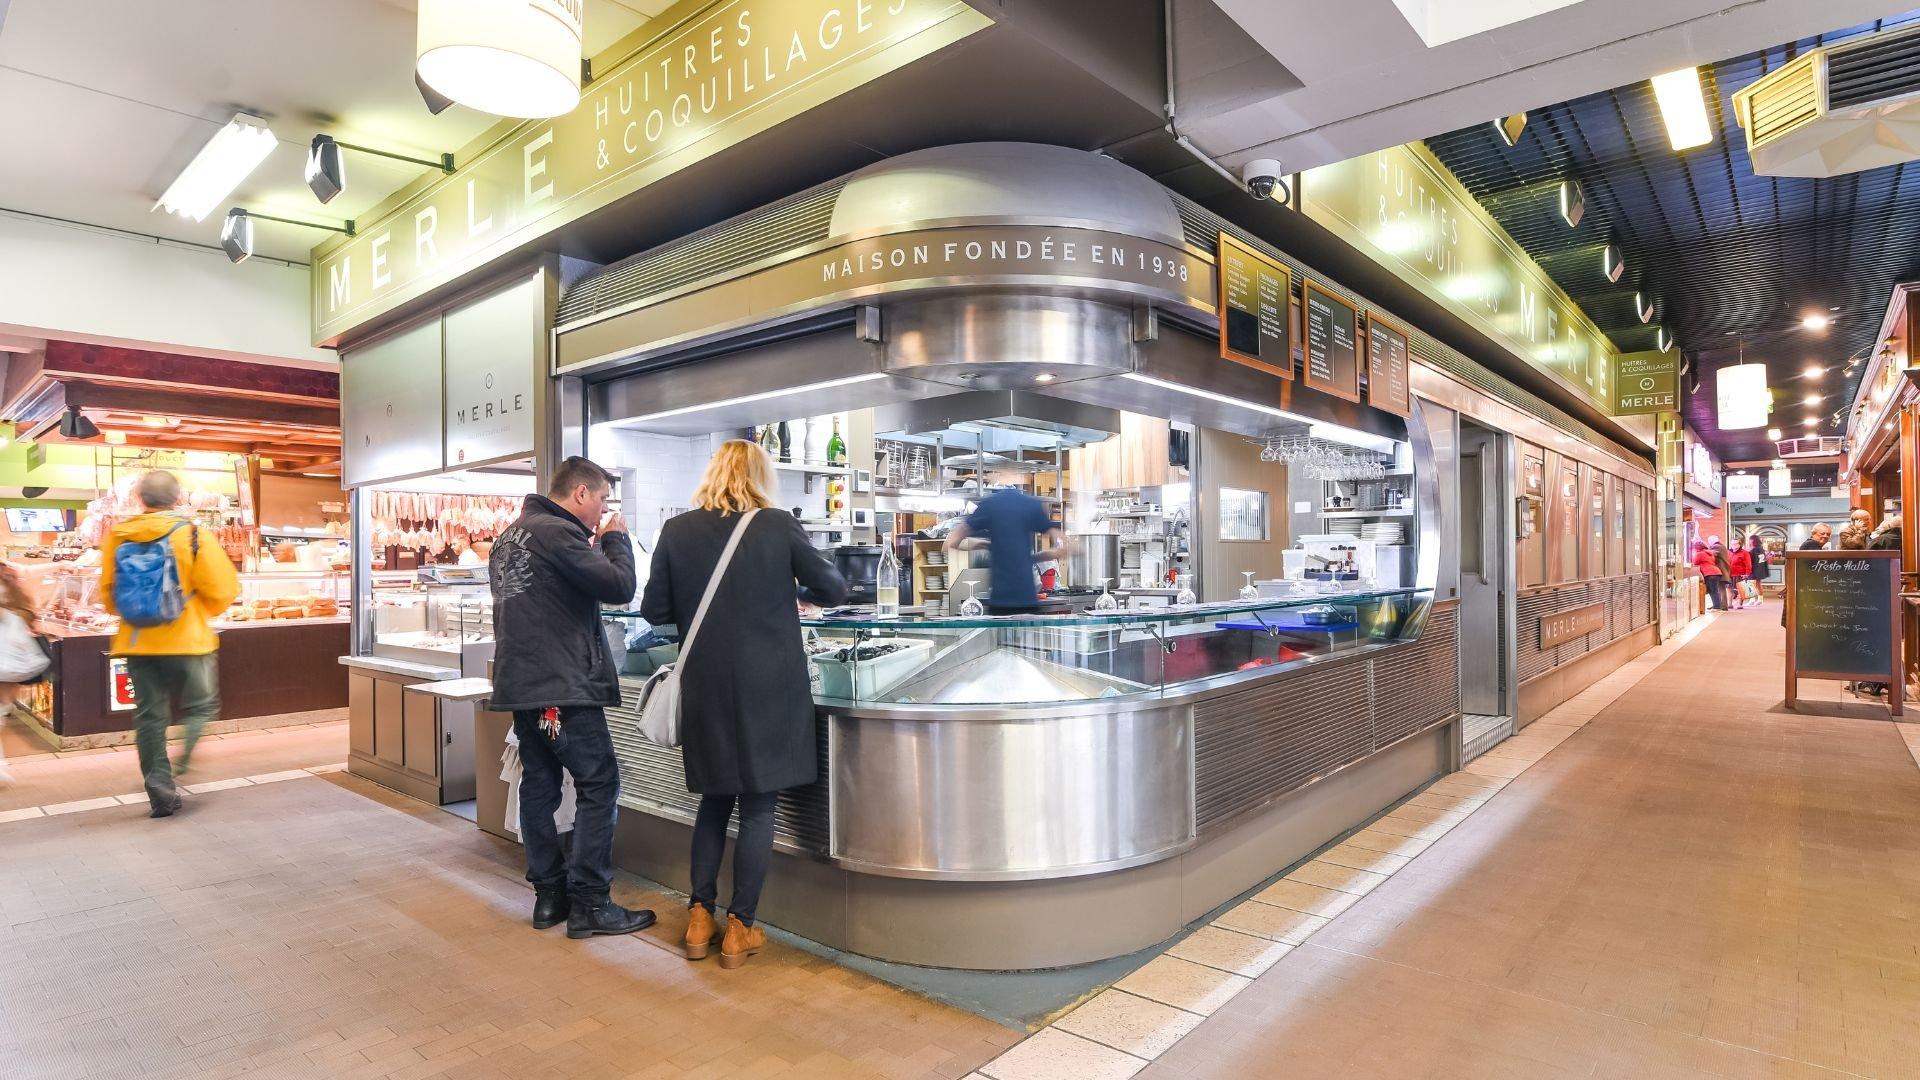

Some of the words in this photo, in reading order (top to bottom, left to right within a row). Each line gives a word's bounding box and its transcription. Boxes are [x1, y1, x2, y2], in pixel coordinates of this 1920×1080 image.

[596, 10, 751, 130] HUITRES
[596, 139, 610, 170] &
[1378, 152, 1458, 245] HUITRES
[330, 127, 554, 313] MERLE
[823, 245, 928, 282] MAISON
[944, 236, 1077, 263] FONDÉE
[1091, 245, 1125, 266] EN
[1138, 253, 1189, 282] 1938
[1520, 281, 1607, 397] MERLE
[1628, 363, 1674, 373] COQUILLAGES
[457, 394, 523, 426] MERLE
[1621, 395, 1674, 408] MERLE
[1843, 560, 1871, 572] Halle
[1546, 616, 1576, 640] MERLE
